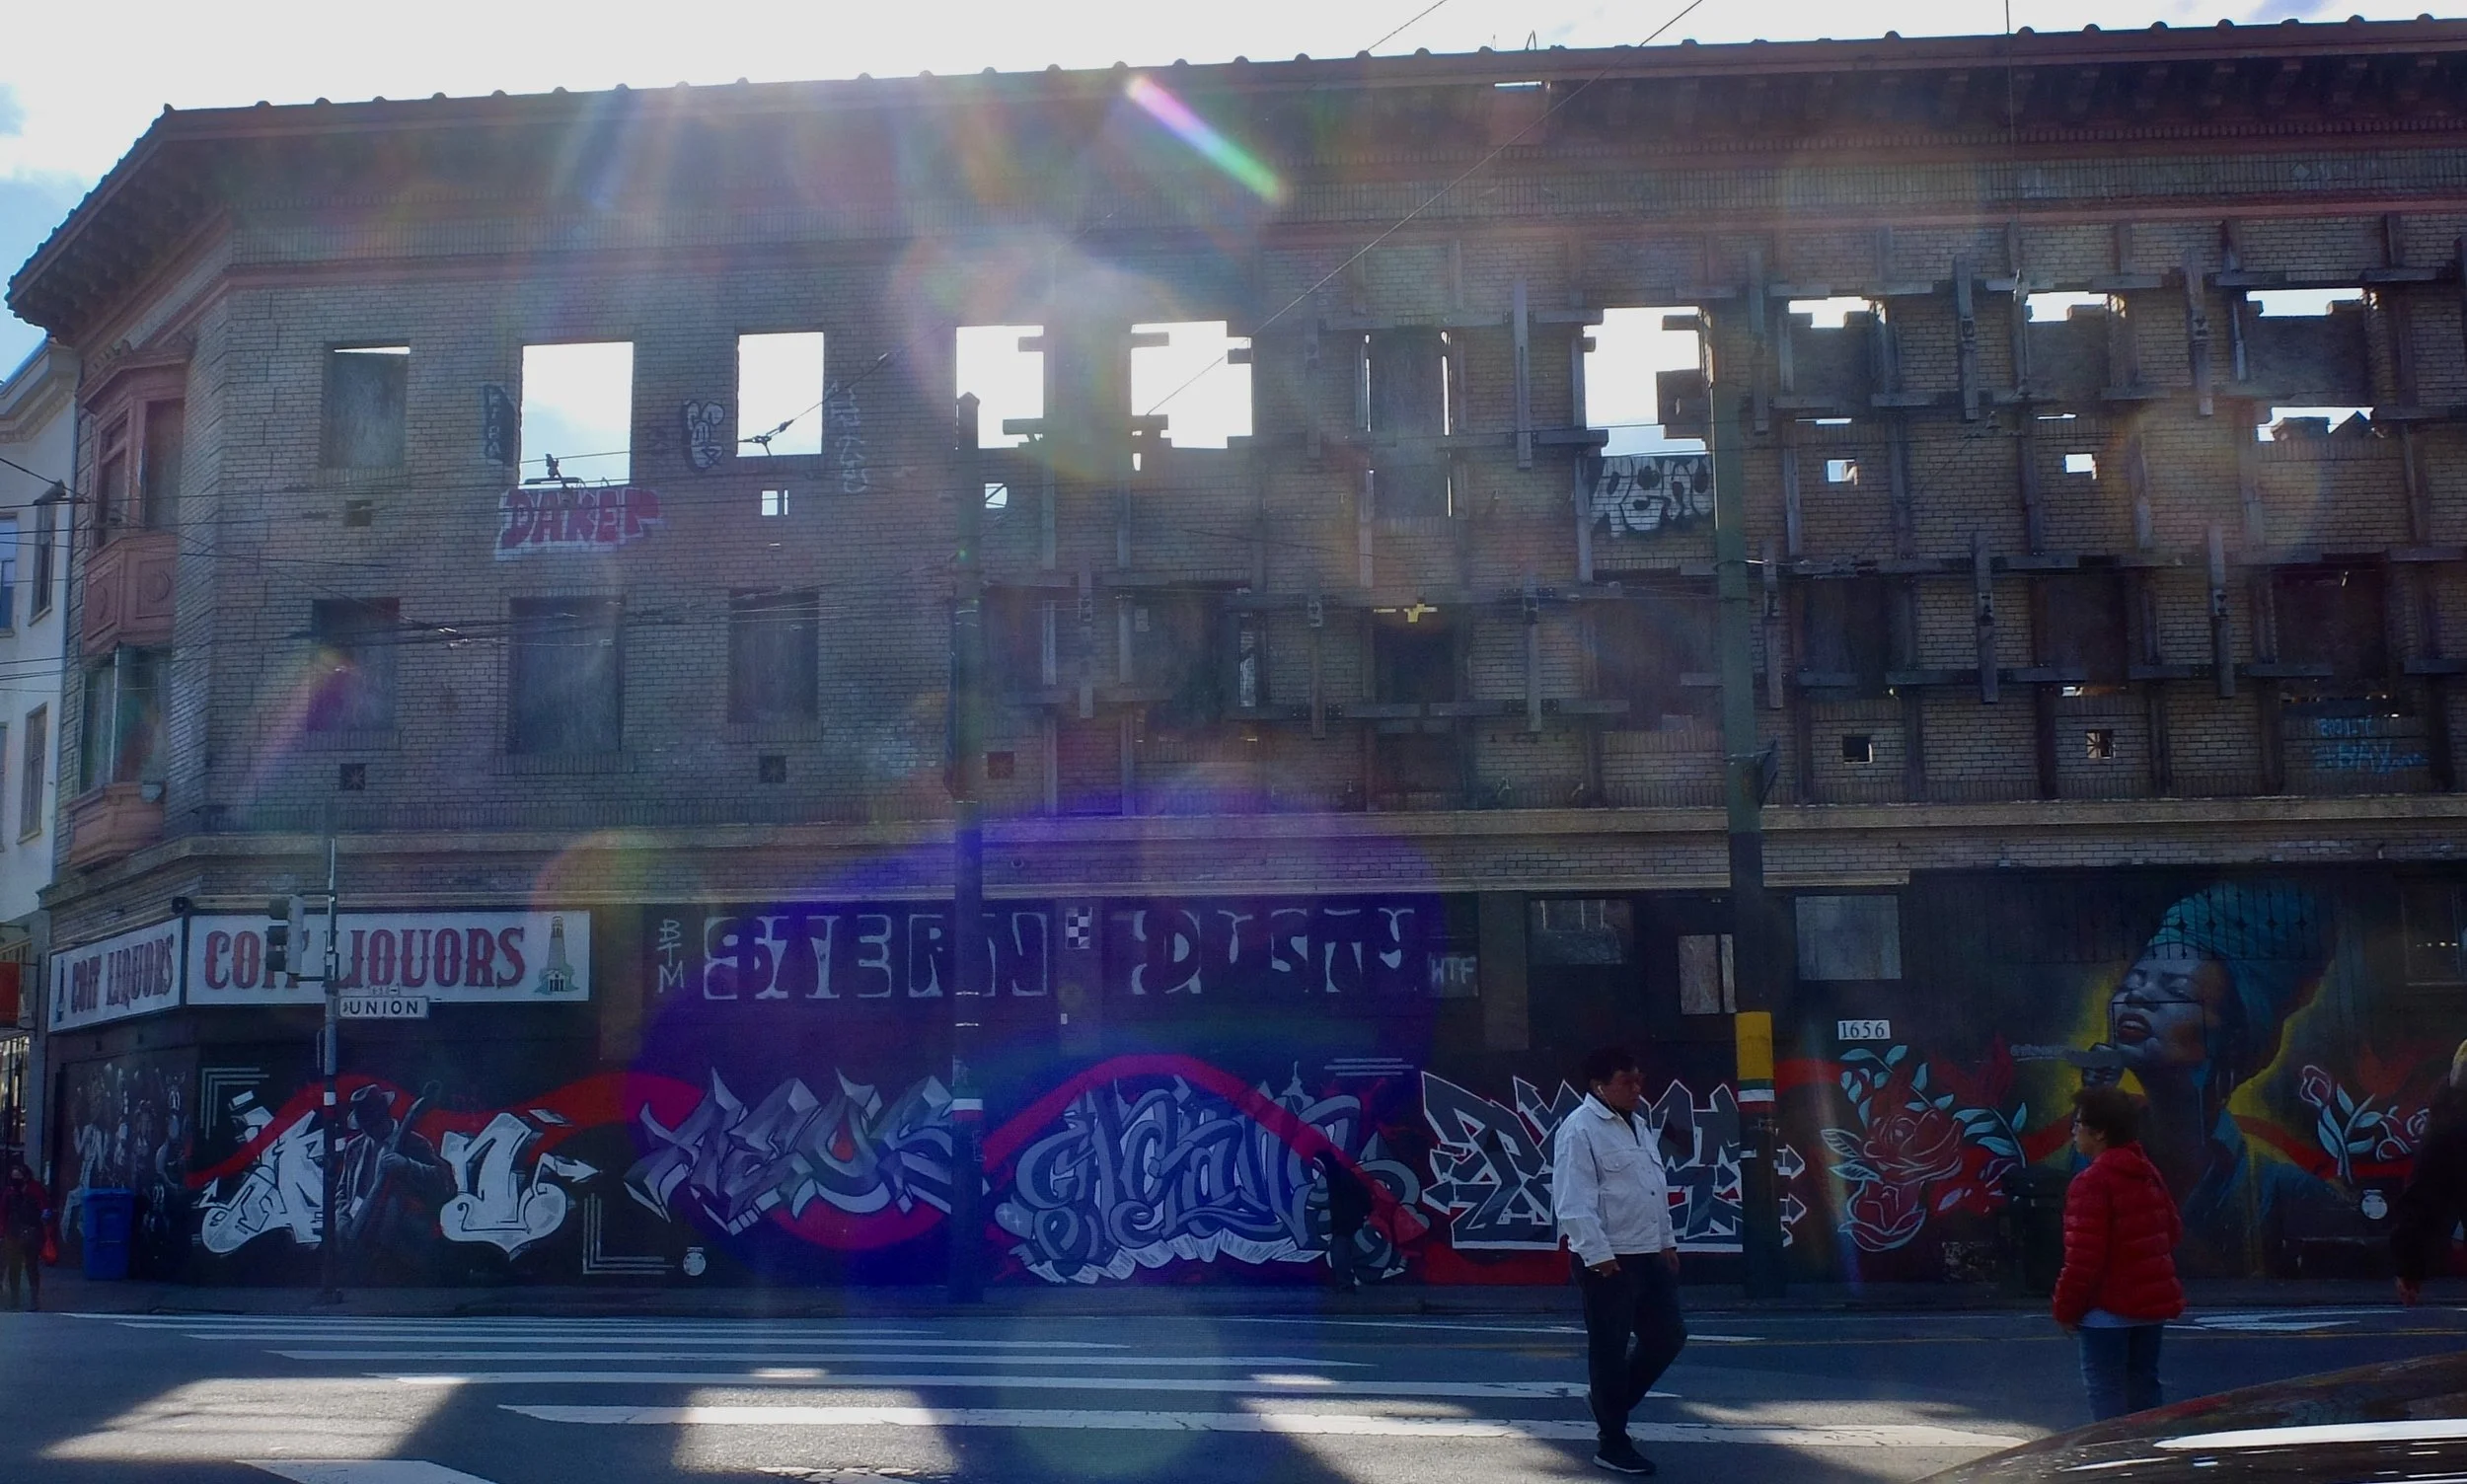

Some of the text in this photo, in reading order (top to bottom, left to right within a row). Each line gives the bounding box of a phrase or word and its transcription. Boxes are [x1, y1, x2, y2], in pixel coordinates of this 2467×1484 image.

[106, 933, 174, 1009] LIQUORS
[349, 1000, 418, 1015] UNION
[1840, 1021, 1885, 1038] 1656
